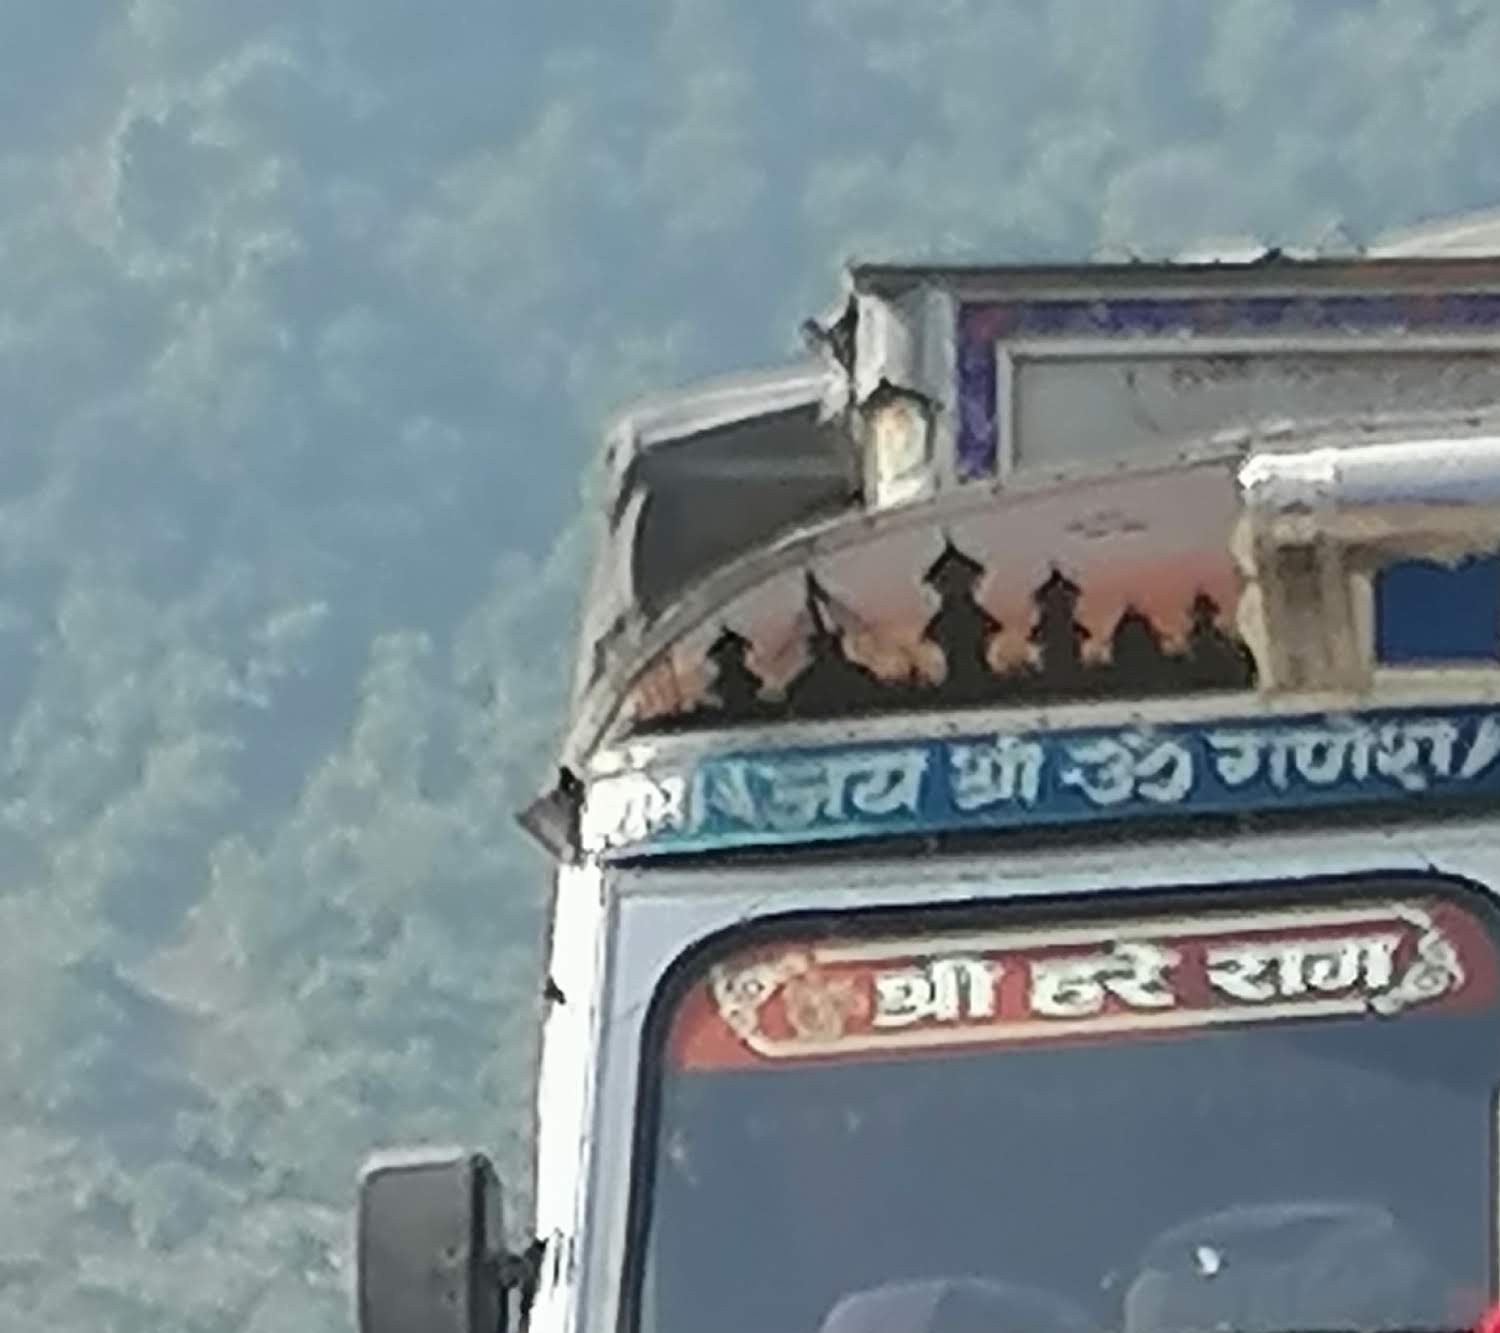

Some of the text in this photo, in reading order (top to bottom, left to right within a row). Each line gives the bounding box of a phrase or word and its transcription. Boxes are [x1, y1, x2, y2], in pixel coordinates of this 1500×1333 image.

[764, 748, 928, 822] जय
[952, 736, 1044, 808] श्री
[1206, 713, 1458, 791] गणेश
[873, 934, 1403, 1028] श्री हरे राम
